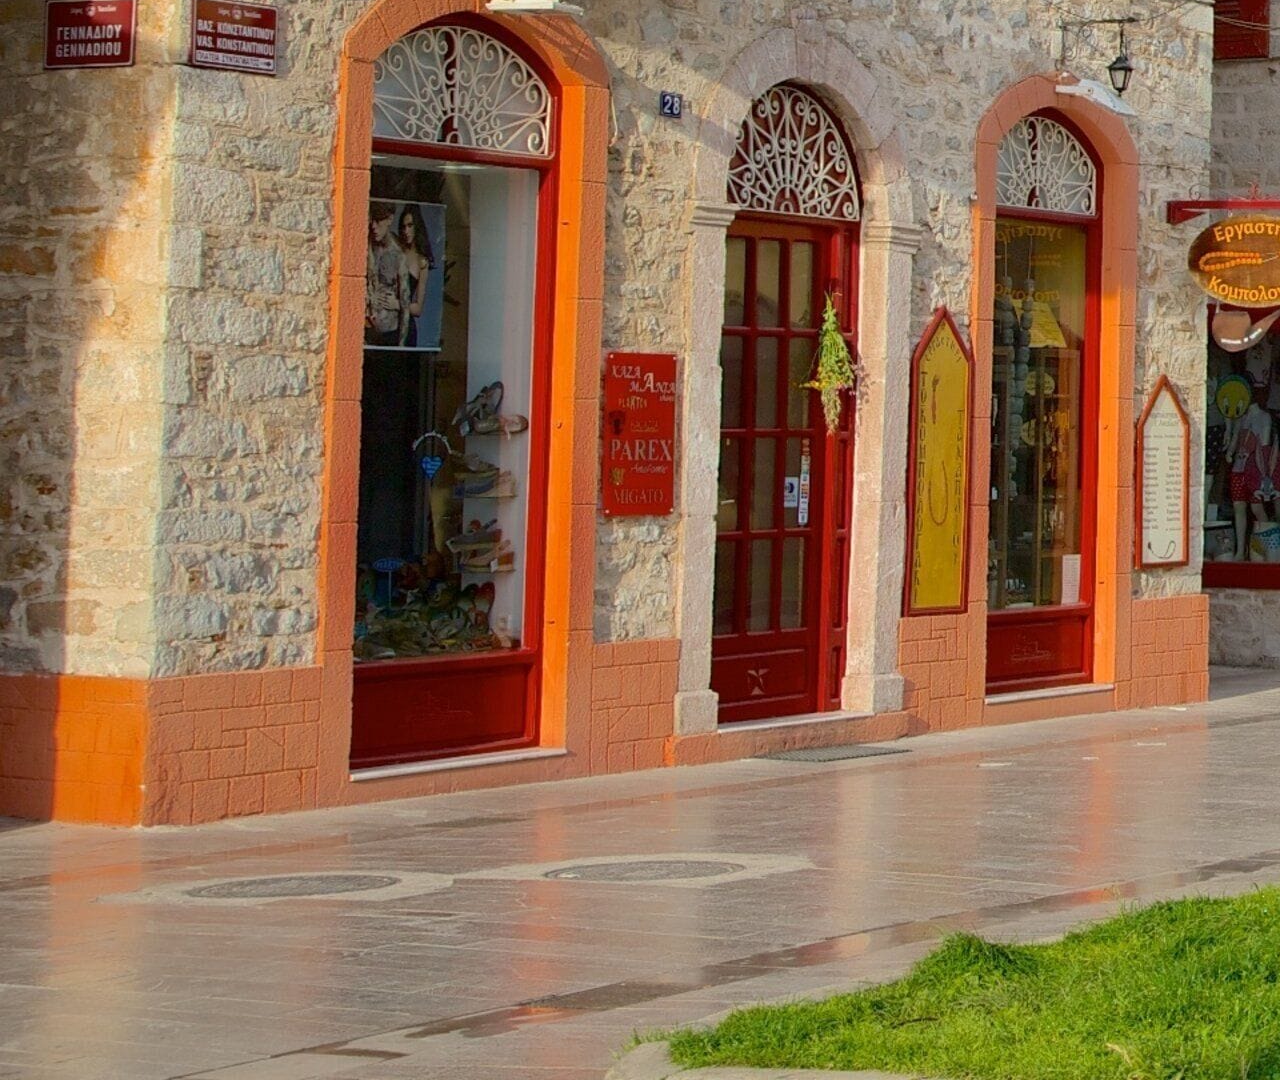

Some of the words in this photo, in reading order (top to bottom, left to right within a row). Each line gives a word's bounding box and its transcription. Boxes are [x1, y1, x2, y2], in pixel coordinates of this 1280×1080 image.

[56, 24, 122, 41] ΓΕΝΝΑΔΙΟΥ
[55, 41, 122, 58] GENNADIOU
[216, 36, 275, 56] KONSTANTINOU
[663, 94, 681, 115] 28
[610, 439, 673, 462] PAREX
